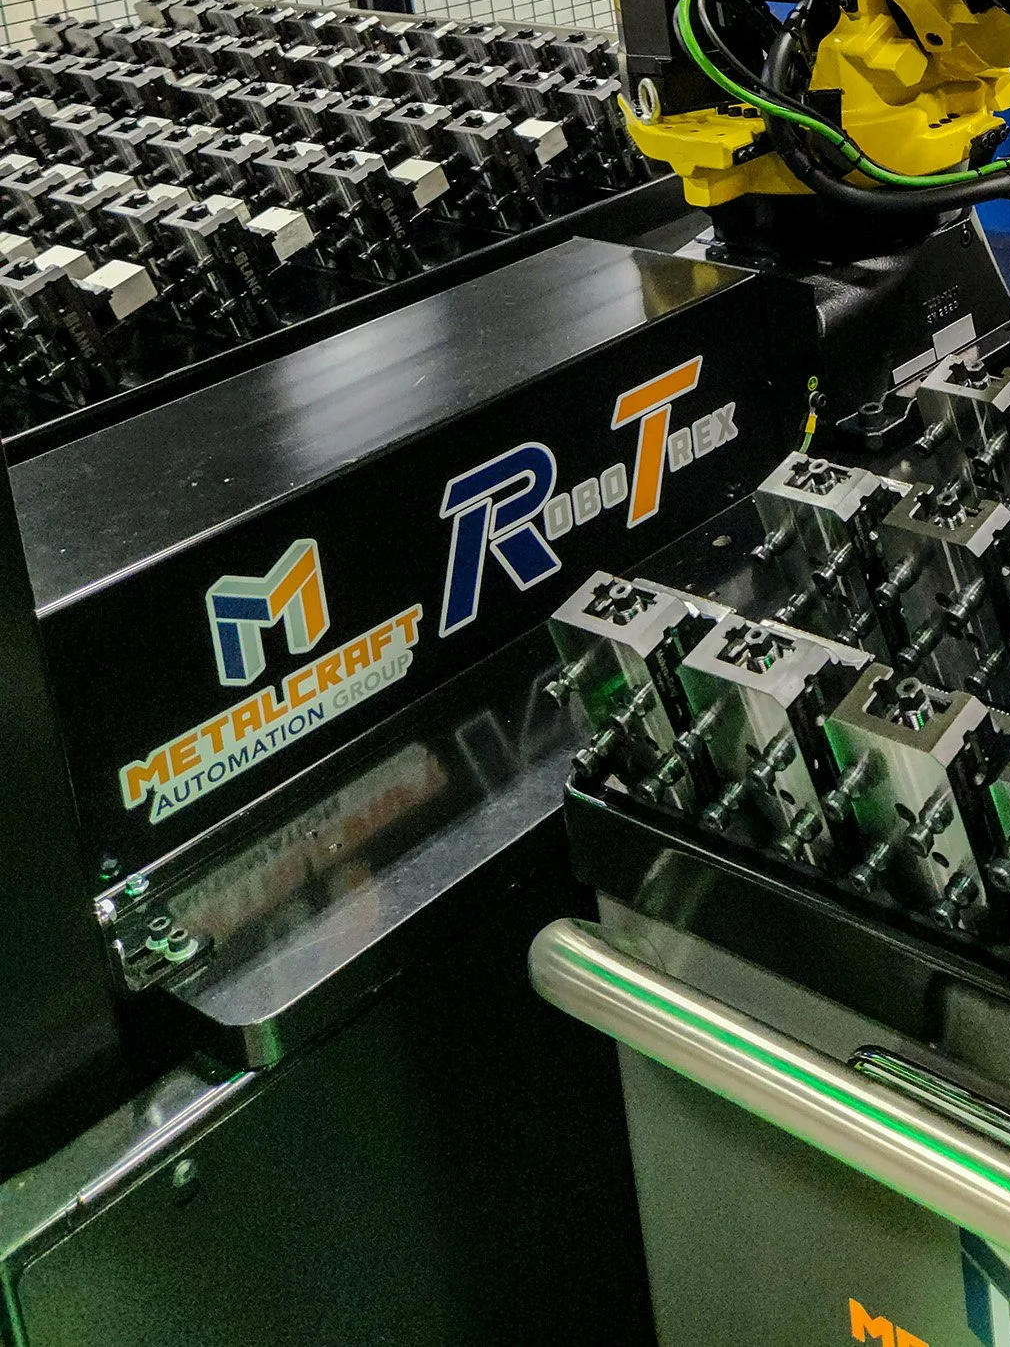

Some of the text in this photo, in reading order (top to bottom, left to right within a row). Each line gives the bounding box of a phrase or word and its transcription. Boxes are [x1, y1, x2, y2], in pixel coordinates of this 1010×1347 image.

[127, 608, 420, 803] METALCRAFT
[154, 651, 411, 816] AUTOMATION GROUP
